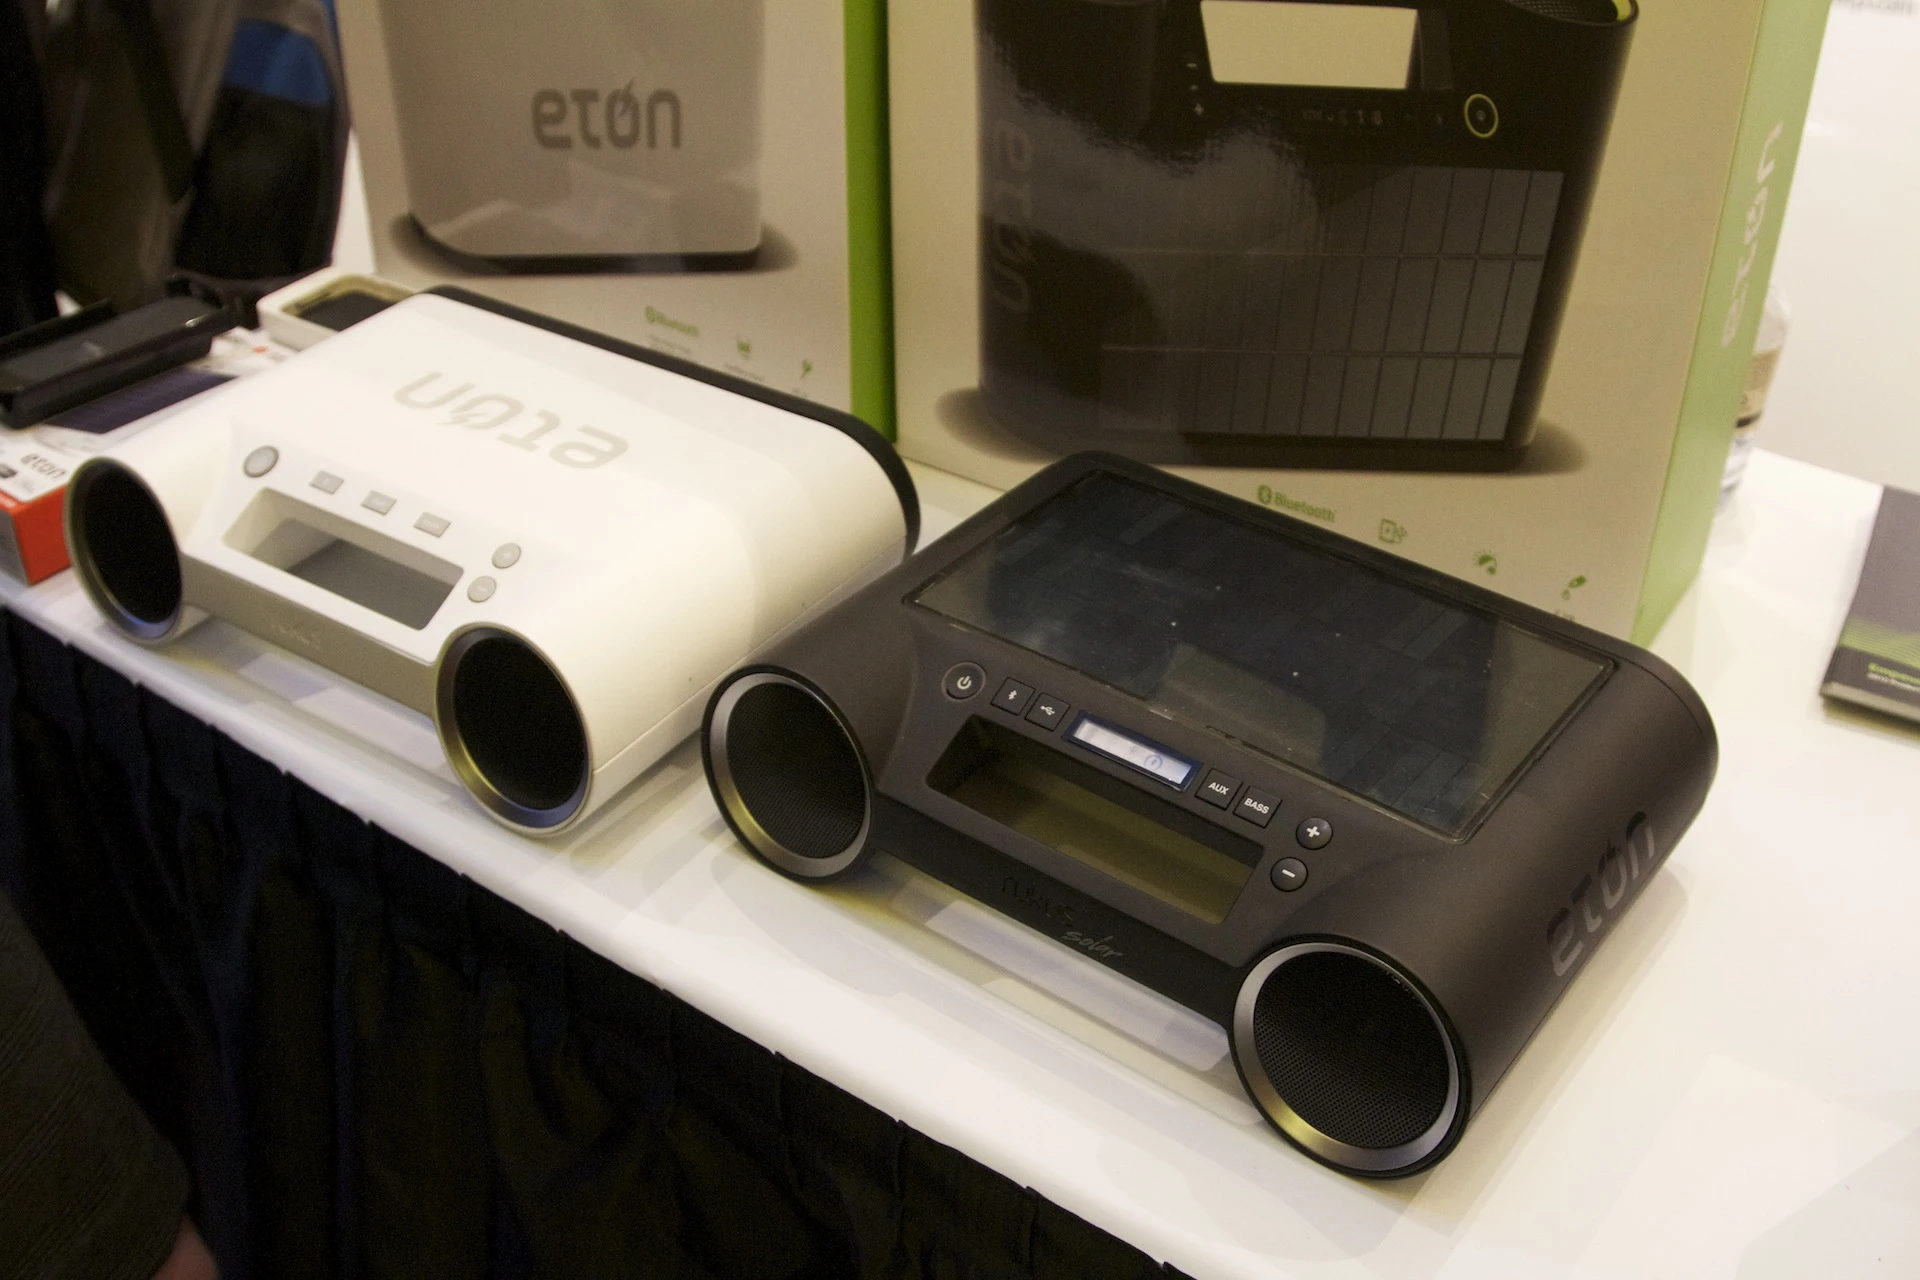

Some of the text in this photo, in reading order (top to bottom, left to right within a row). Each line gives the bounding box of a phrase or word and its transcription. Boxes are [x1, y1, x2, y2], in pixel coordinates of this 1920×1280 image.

[1208, 781, 1229, 795] AUX
[1243, 797, 1270, 814] BASS
[1061, 931, 1124, 958] solar
